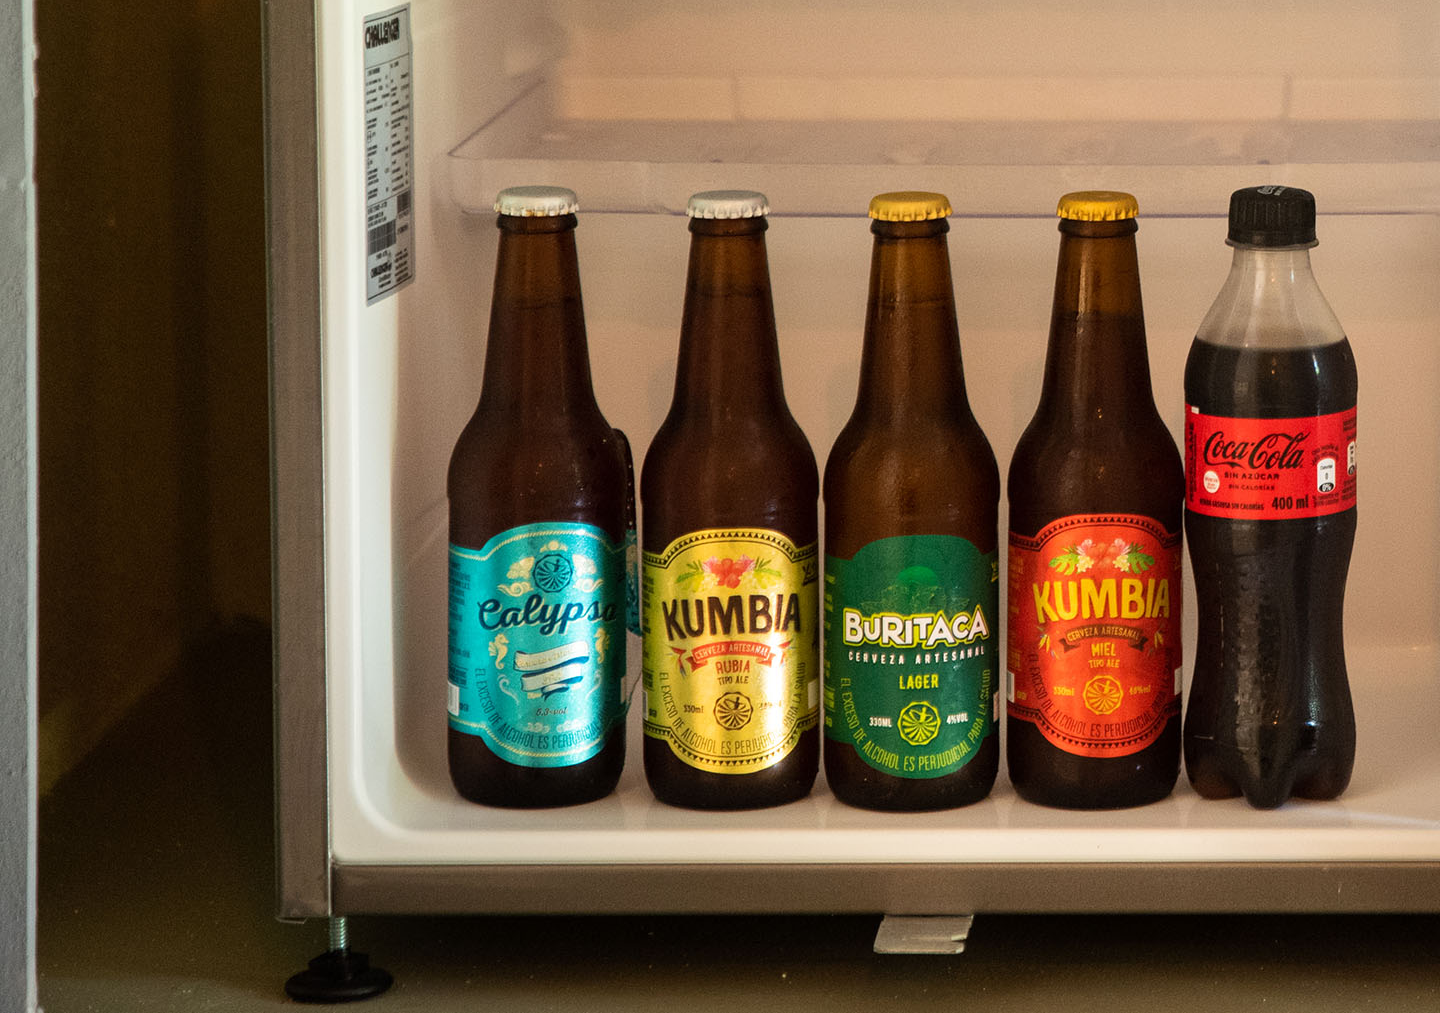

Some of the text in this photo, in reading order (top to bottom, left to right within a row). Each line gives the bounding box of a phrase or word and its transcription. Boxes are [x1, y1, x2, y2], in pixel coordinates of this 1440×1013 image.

[1224, 471, 1280, 480] SIN AZÚCAR
[1272, 497, 1292, 510] 400
[1296, 494, 1308, 508] ml
[1032, 578, 1170, 623] KUMBIA
[477, 594, 617, 636] Calypso
[661, 593, 801, 641] KUMBIA
[843, 605, 989, 648] BURITACA
[1067, 627, 1098, 642] CERVEZA
[695, 646, 769, 660] CERVEZA ARTESANAL
[849, 646, 984, 664] CERVEZA ARTESANAL
[1091, 643, 1116, 657] MIEL
[716, 660, 750, 674] RUBIA
[1088, 659, 1120, 668] TIPO ALE
[475, 667, 486, 677] EL
[660, 672, 669, 681] EL
[794, 662, 806, 691] SALUD
[717, 676, 749, 685] TIPO ALE
[840, 677, 851, 687] EL
[899, 674, 939, 690] LAGER
[477, 681, 495, 714] EXCESO
[661, 684, 677, 718] EXCESO
[795, 693, 802, 703] LA
[841, 691, 859, 729] EXCESO
[978, 704, 987, 715] LA
[489, 713, 501, 727] DE
[672, 717, 684, 733] DE
[869, 716, 892, 727] 330ML
[1051, 710, 1086, 736] ALCOHOL
[1090, 724, 1102, 737] ES
[498, 723, 534, 748] ALCOHOL
[853, 729, 867, 743] DE
[967, 719, 985, 744] PARA
[538, 736, 549, 749] ES
[682, 728, 717, 754] ALCOHOL
[721, 742, 731, 754] ES
[863, 740, 899, 771] ALCOHOL
[919, 742, 971, 771] PERJUDICIAL
[904, 756, 915, 772] ES
